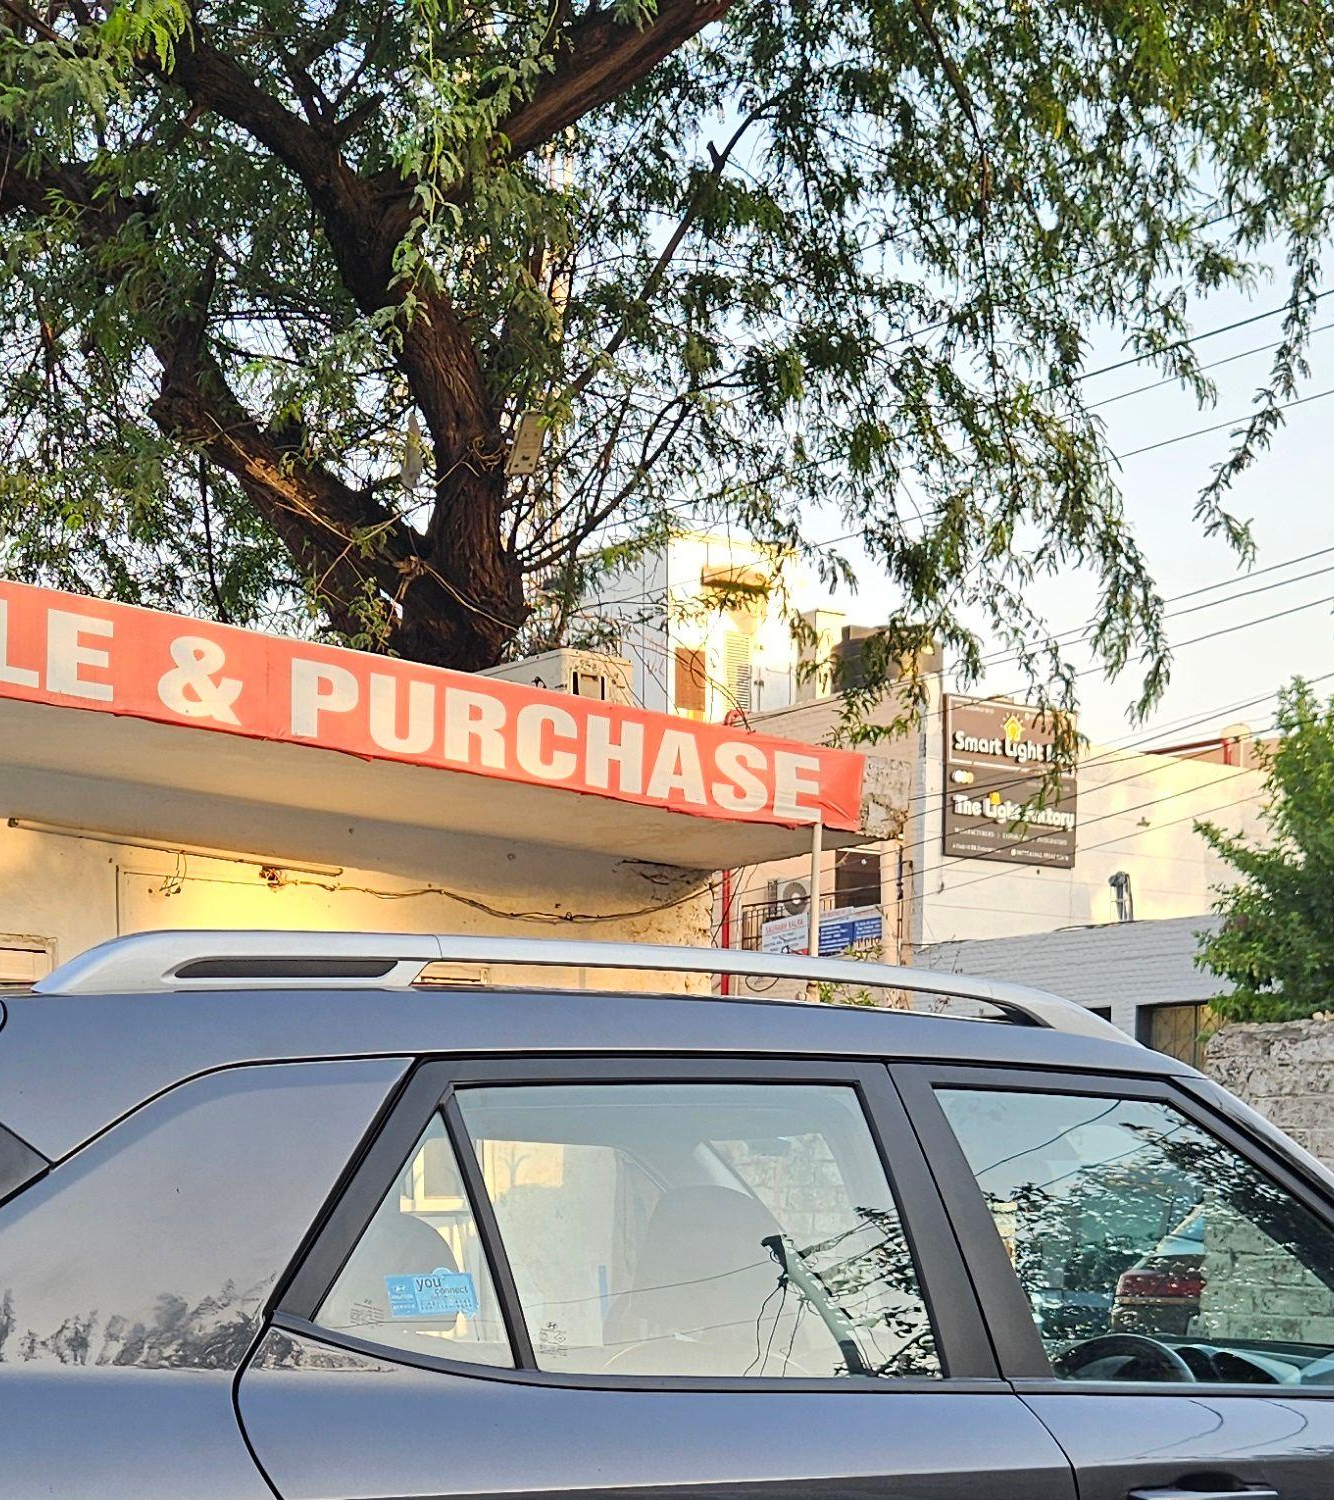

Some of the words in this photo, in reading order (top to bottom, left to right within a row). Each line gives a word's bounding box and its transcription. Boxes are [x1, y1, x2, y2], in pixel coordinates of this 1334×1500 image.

[157, 635, 243, 727] &
[290, 657, 823, 823] PURCHASE
[954, 730, 1003, 756] Smart
[1004, 738, 1044, 764] Light
[953, 794, 982, 817] The
[416, 1277, 442, 1292] you
